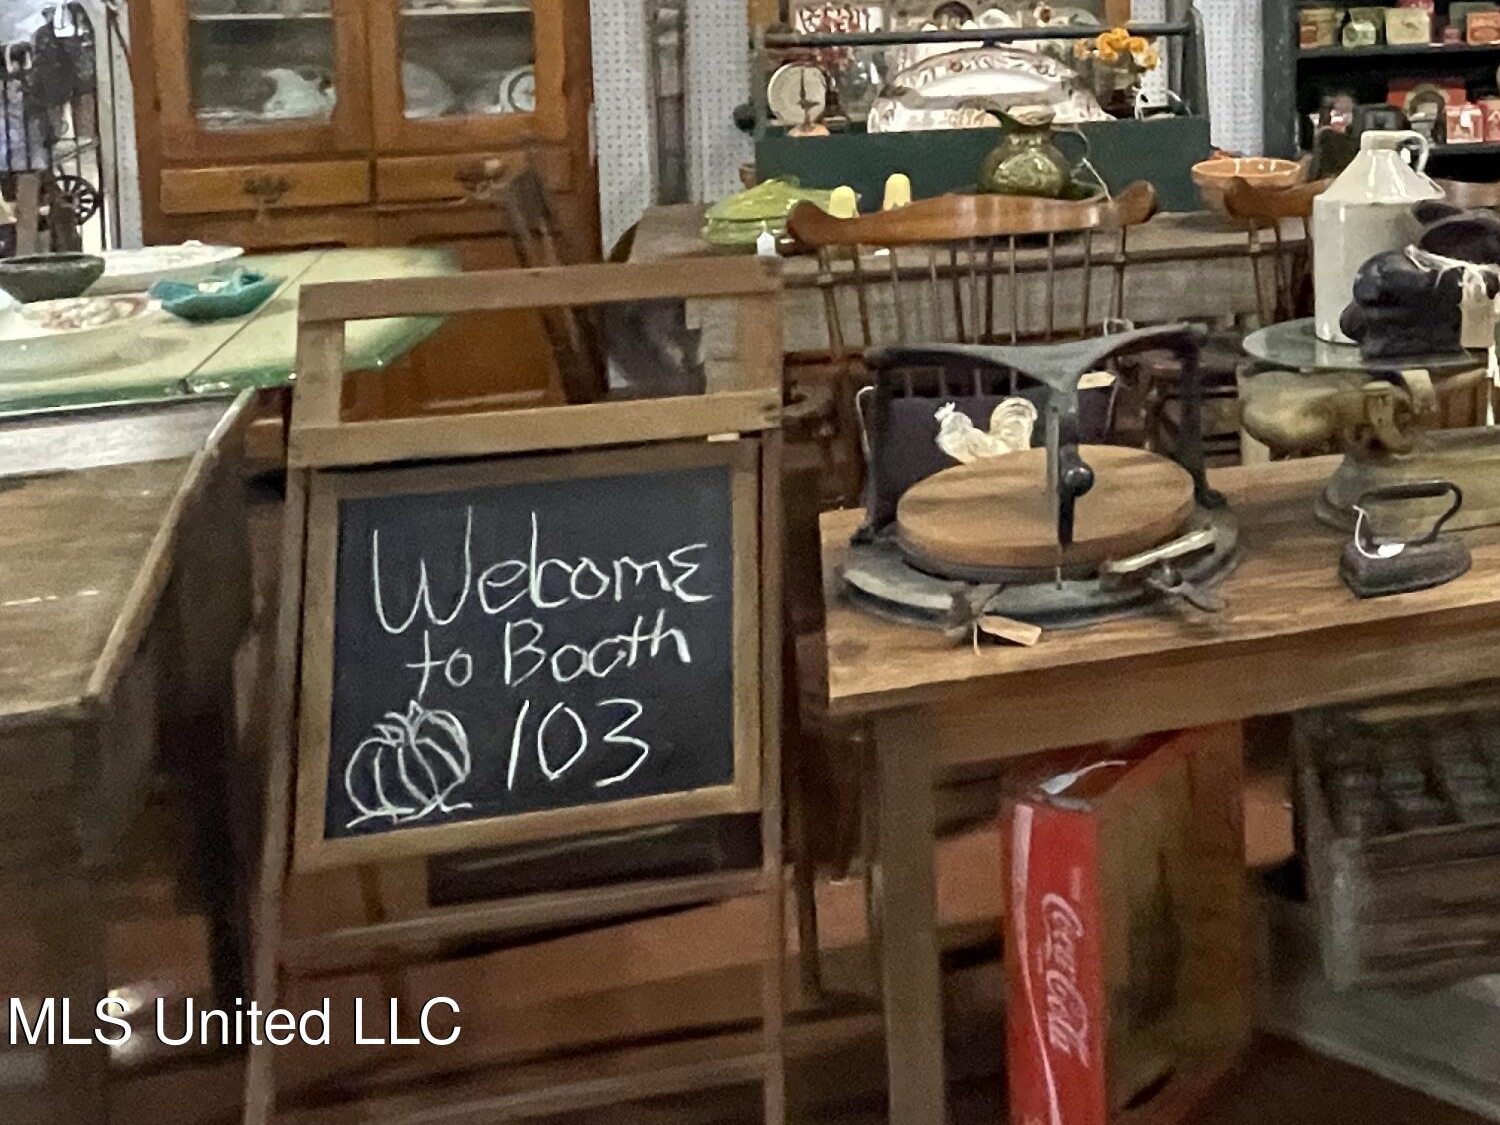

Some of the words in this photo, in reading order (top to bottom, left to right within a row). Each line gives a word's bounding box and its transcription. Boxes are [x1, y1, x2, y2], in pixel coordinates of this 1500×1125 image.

[372, 505, 714, 634] Welcome
[406, 630, 473, 702] to
[503, 609, 692, 687] Booth
[507, 698, 650, 791] 103
